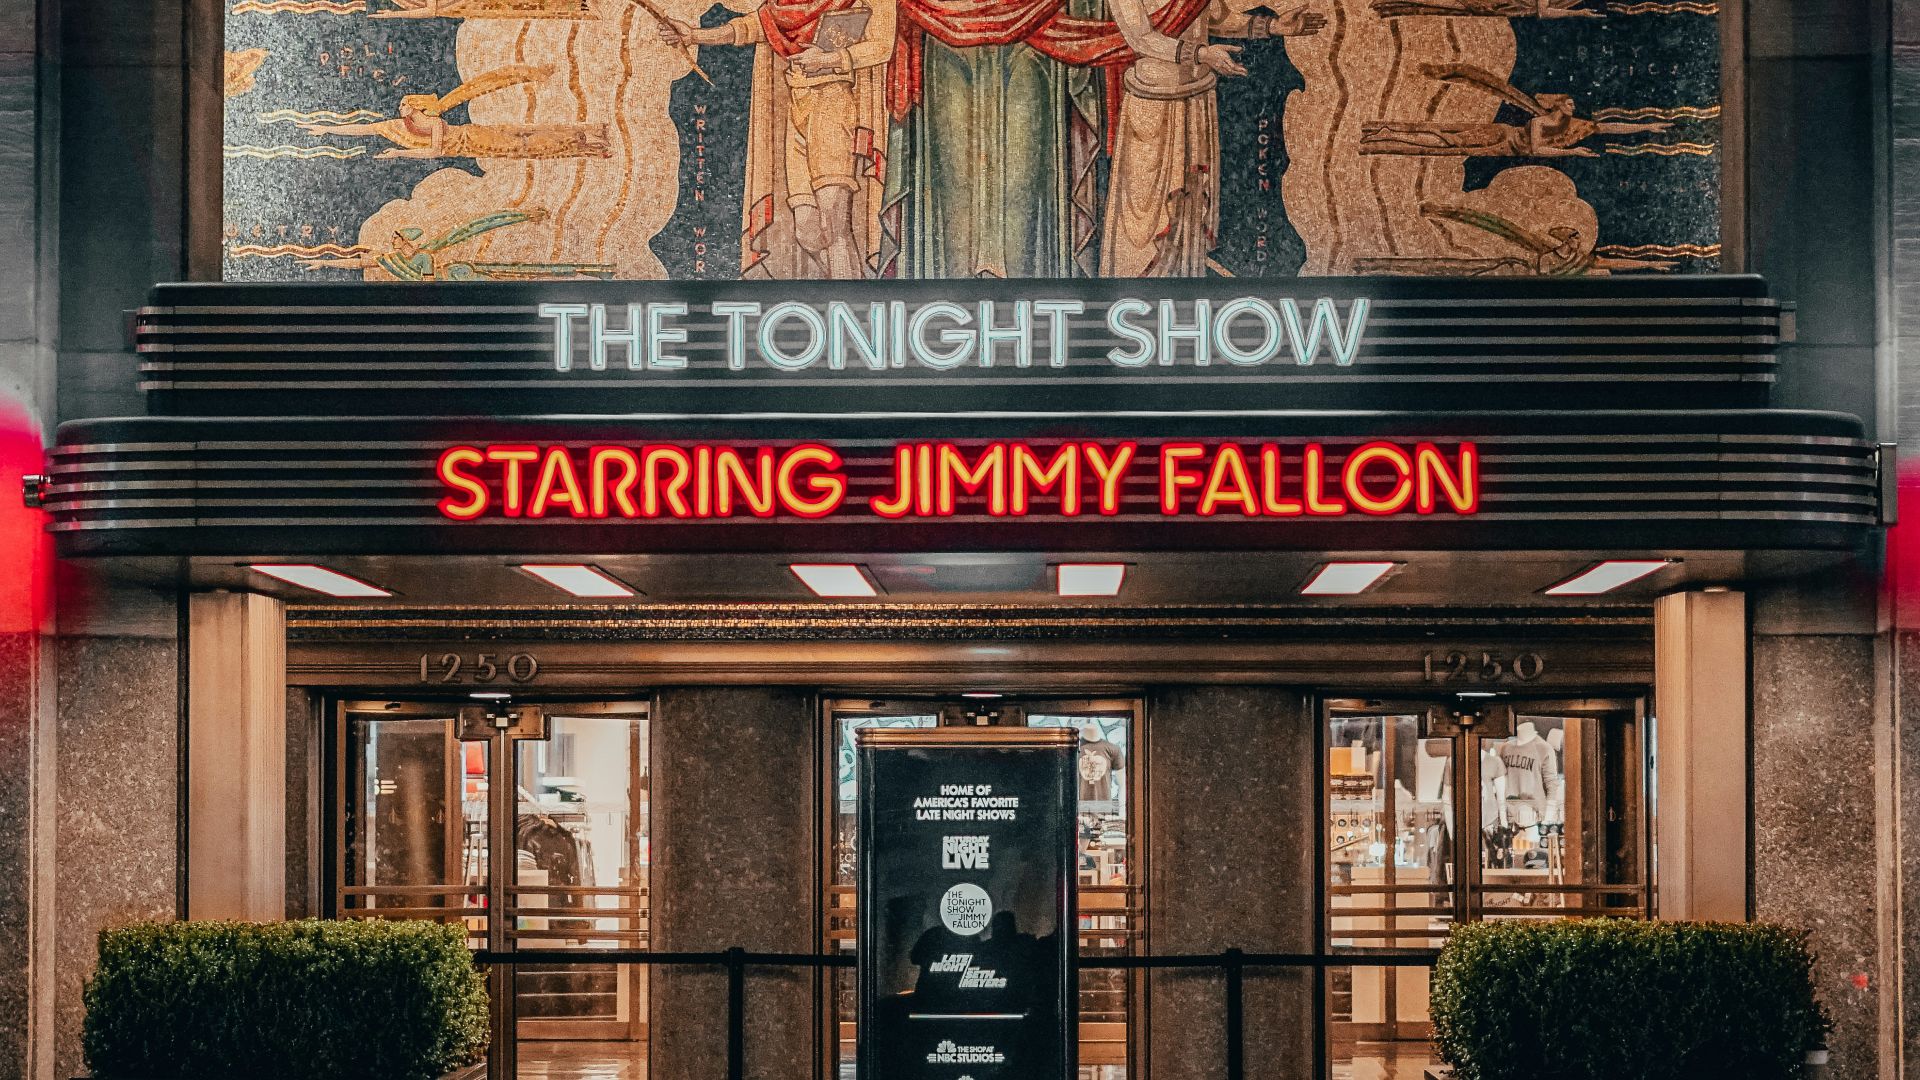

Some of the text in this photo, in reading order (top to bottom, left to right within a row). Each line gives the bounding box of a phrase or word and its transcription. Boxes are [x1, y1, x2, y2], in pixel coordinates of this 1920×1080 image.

[693, 104, 707, 280] WRITTEN WOR
[539, 296, 1372, 372] THE TONIGHT SHOW
[437, 441, 1480, 520] STARRING JIMMY FALLON
[420, 653, 538, 682] 1250
[1424, 652, 1544, 681] 1250
[940, 785, 992, 796] HOME OF
[913, 797, 1019, 808] AMERICA'S FAVORITE
[916, 809, 1016, 820] LATE NIGHT SHOWS
[942, 842, 989, 854] NIGHT
[942, 853, 989, 869] LIVE
[947, 891, 963, 899] THE
[947, 898, 986, 906] TONIGHT
[946, 905, 975, 914] SHOW
[958, 913, 987, 921] JIMMY
[952, 920, 985, 929] FALLON
[942, 954, 969, 963] LATE
[930, 962, 967, 972] NIGHT
[965, 970, 996, 979] SETH
[961, 978, 1007, 988] MEYERS
[937, 1053, 995, 1063] NBC STUDIOS
